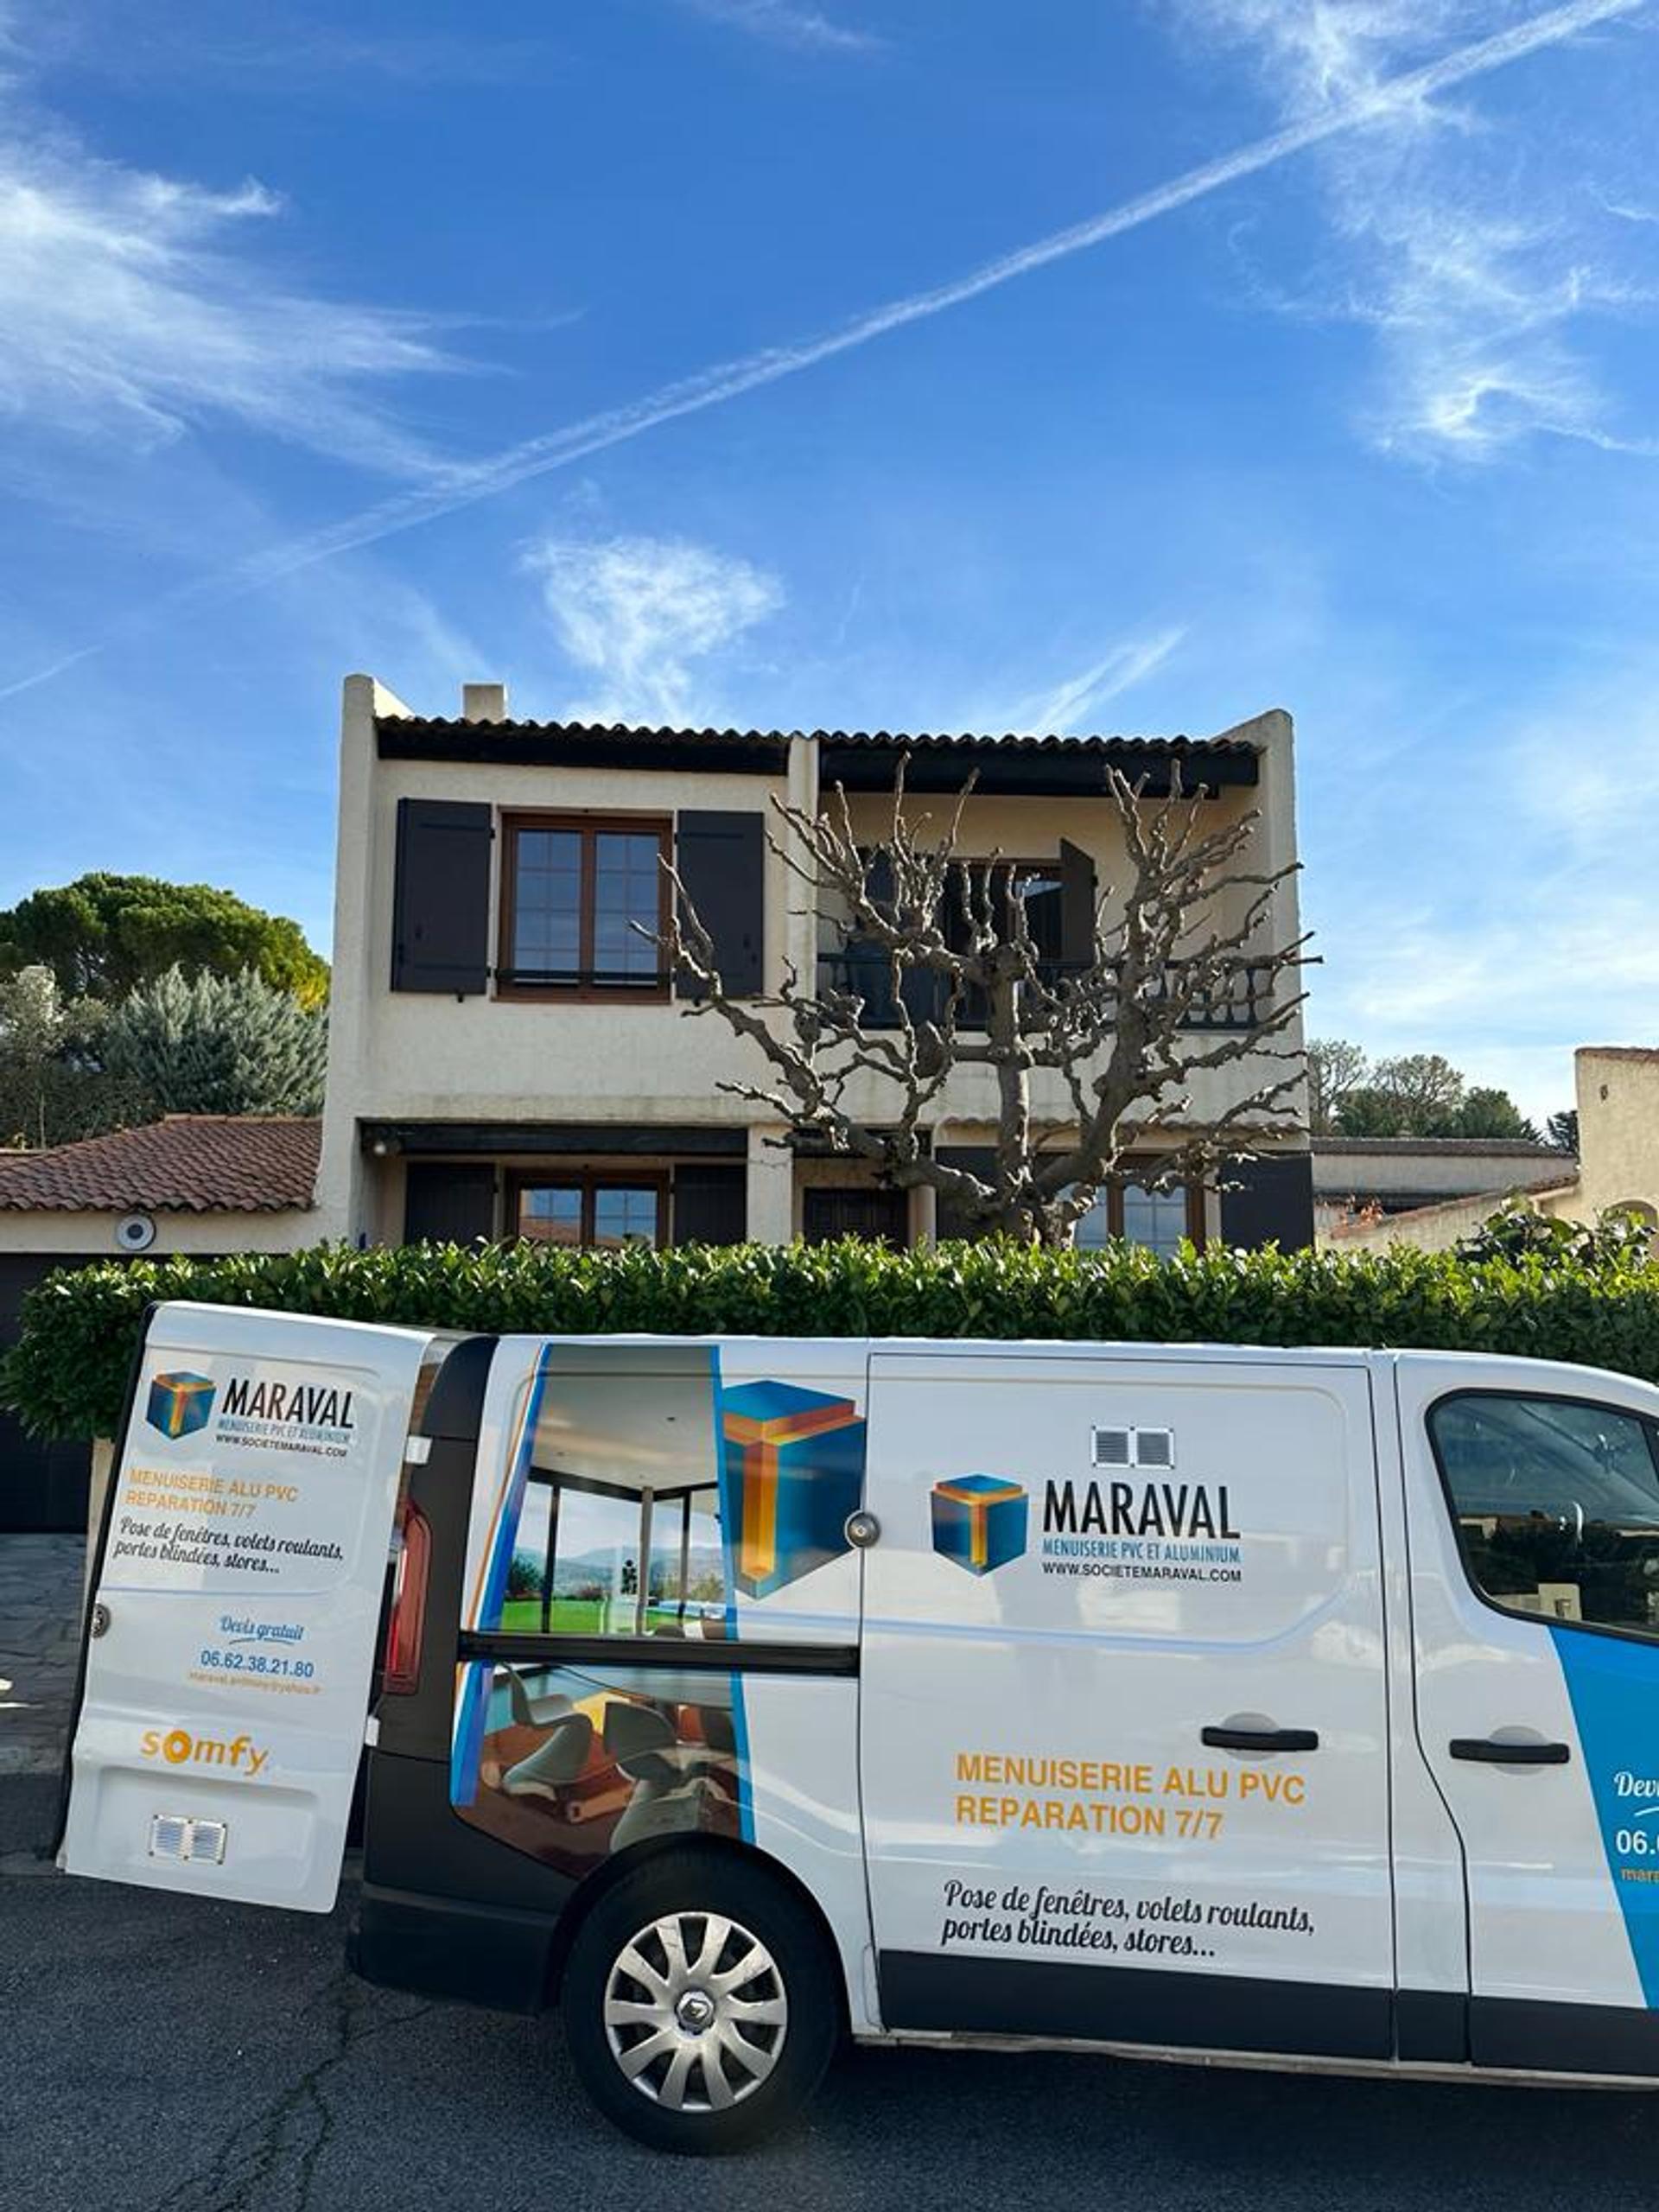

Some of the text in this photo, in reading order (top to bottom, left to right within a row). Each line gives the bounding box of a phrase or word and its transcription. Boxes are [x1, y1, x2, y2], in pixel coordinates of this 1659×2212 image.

[222, 1377, 353, 1429] MARAVAL
[216, 1433, 349, 1458] WWW.SOCIETEMARAVAL.COM
[129, 1470, 299, 1503] MENUISERIE ALU PVC
[125, 1490, 257, 1519] REPARATION 7/7
[1043, 1479, 1242, 1540] MARAVAL
[119, 1516, 149, 1537] Pose
[153, 1522, 172, 1539] de
[234, 1533, 276, 1553] volets
[278, 1539, 344, 1560] roulants,
[1041, 1539, 1242, 1564] MENUISERIE PVC ET ALUMINIUM
[112, 1541, 281, 1574] portes blindées, stores...
[1042, 1562, 1243, 1583] WWW.SOCIETEMARAVAL.COM
[220, 1616, 304, 1642] Devis gratuit
[200, 1649, 315, 1678] 06.62.38.21.80
[140, 1729, 270, 1777] somfy
[956, 1754, 1306, 1804] MENUISERIE ALU PVC
[1613, 1770, 1659, 1797] Dev
[956, 1795, 1224, 1840] REPARATION 7/7
[1616, 1829, 1659, 1855] 06.
[944, 1879, 1314, 1936] Pose de fenêtres, volets roulants,
[941, 1917, 1216, 1957] portes blindées, stores...
